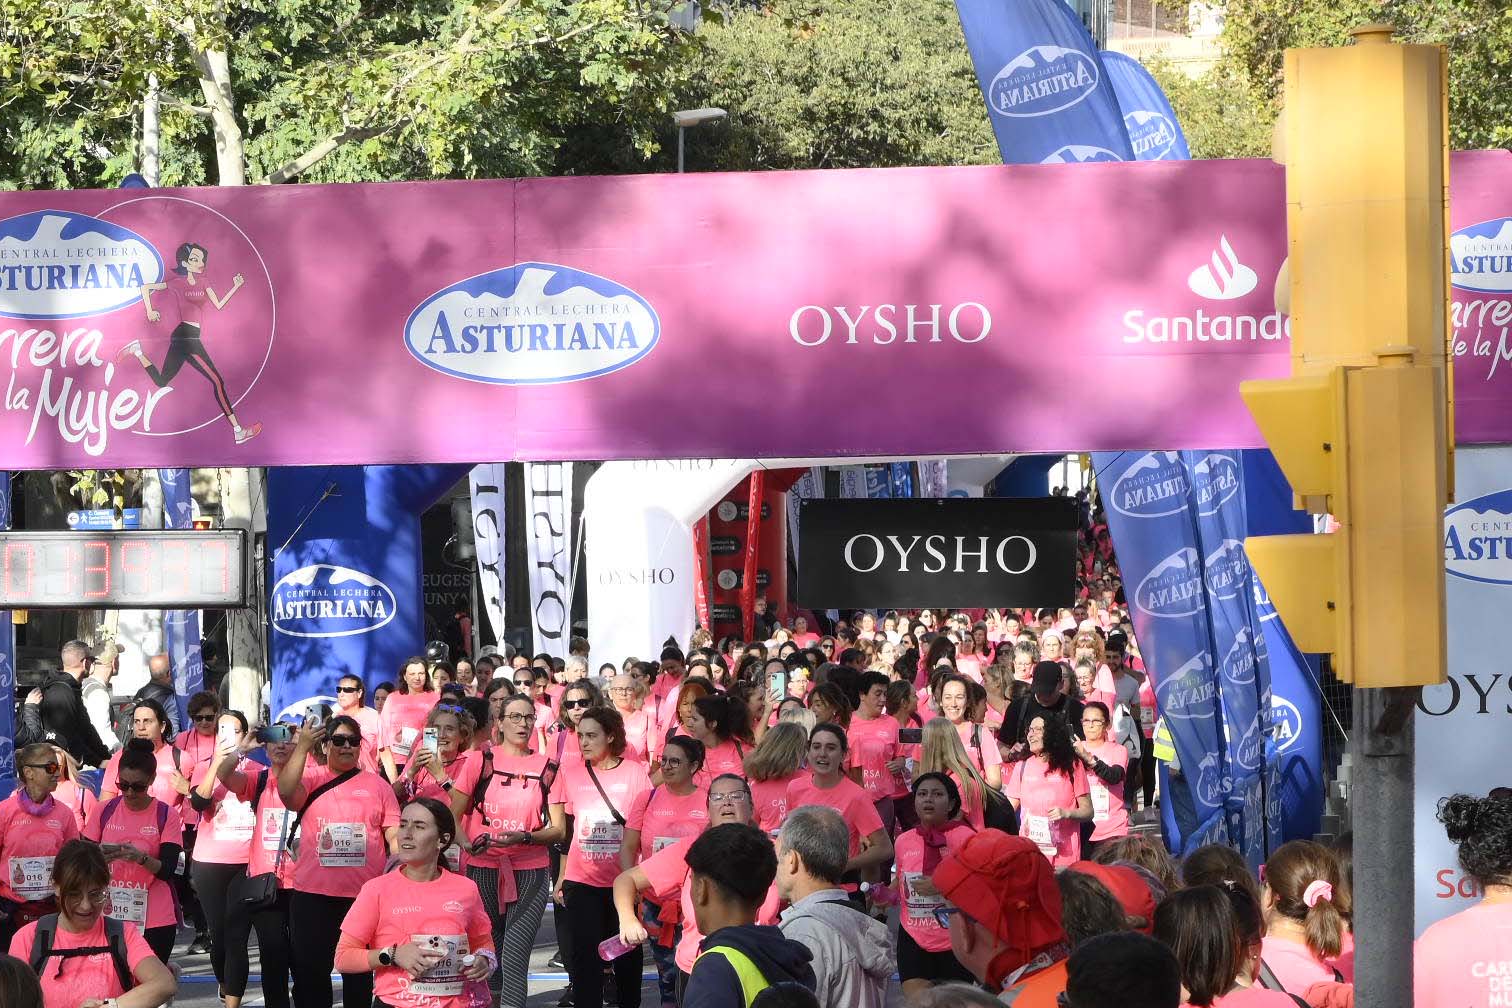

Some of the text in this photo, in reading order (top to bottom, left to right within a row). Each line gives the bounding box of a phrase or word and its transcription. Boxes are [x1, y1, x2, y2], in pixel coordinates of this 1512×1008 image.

[66, 247, 138, 257] LECHERA
[464, 304, 631, 318] CENTRAL LECHERA
[424, 310, 639, 354] ASTURIANA
[789, 302, 992, 346] OYSHO
[1123, 309, 1292, 343] Santand
[1473, 330, 1490, 356] la
[5, 371, 30, 410] la
[24, 362, 174, 457] Mujer
[1470, 523, 1512, 532] CENT
[844, 533, 1037, 574] OYSHO
[599, 567, 675, 585] OYSHO
[287, 588, 382, 597] CENTRAL LECHERA
[273, 594, 388, 622] ASTURIANA
[334, 839, 351, 847] 016
[113, 905, 129, 913] 016
